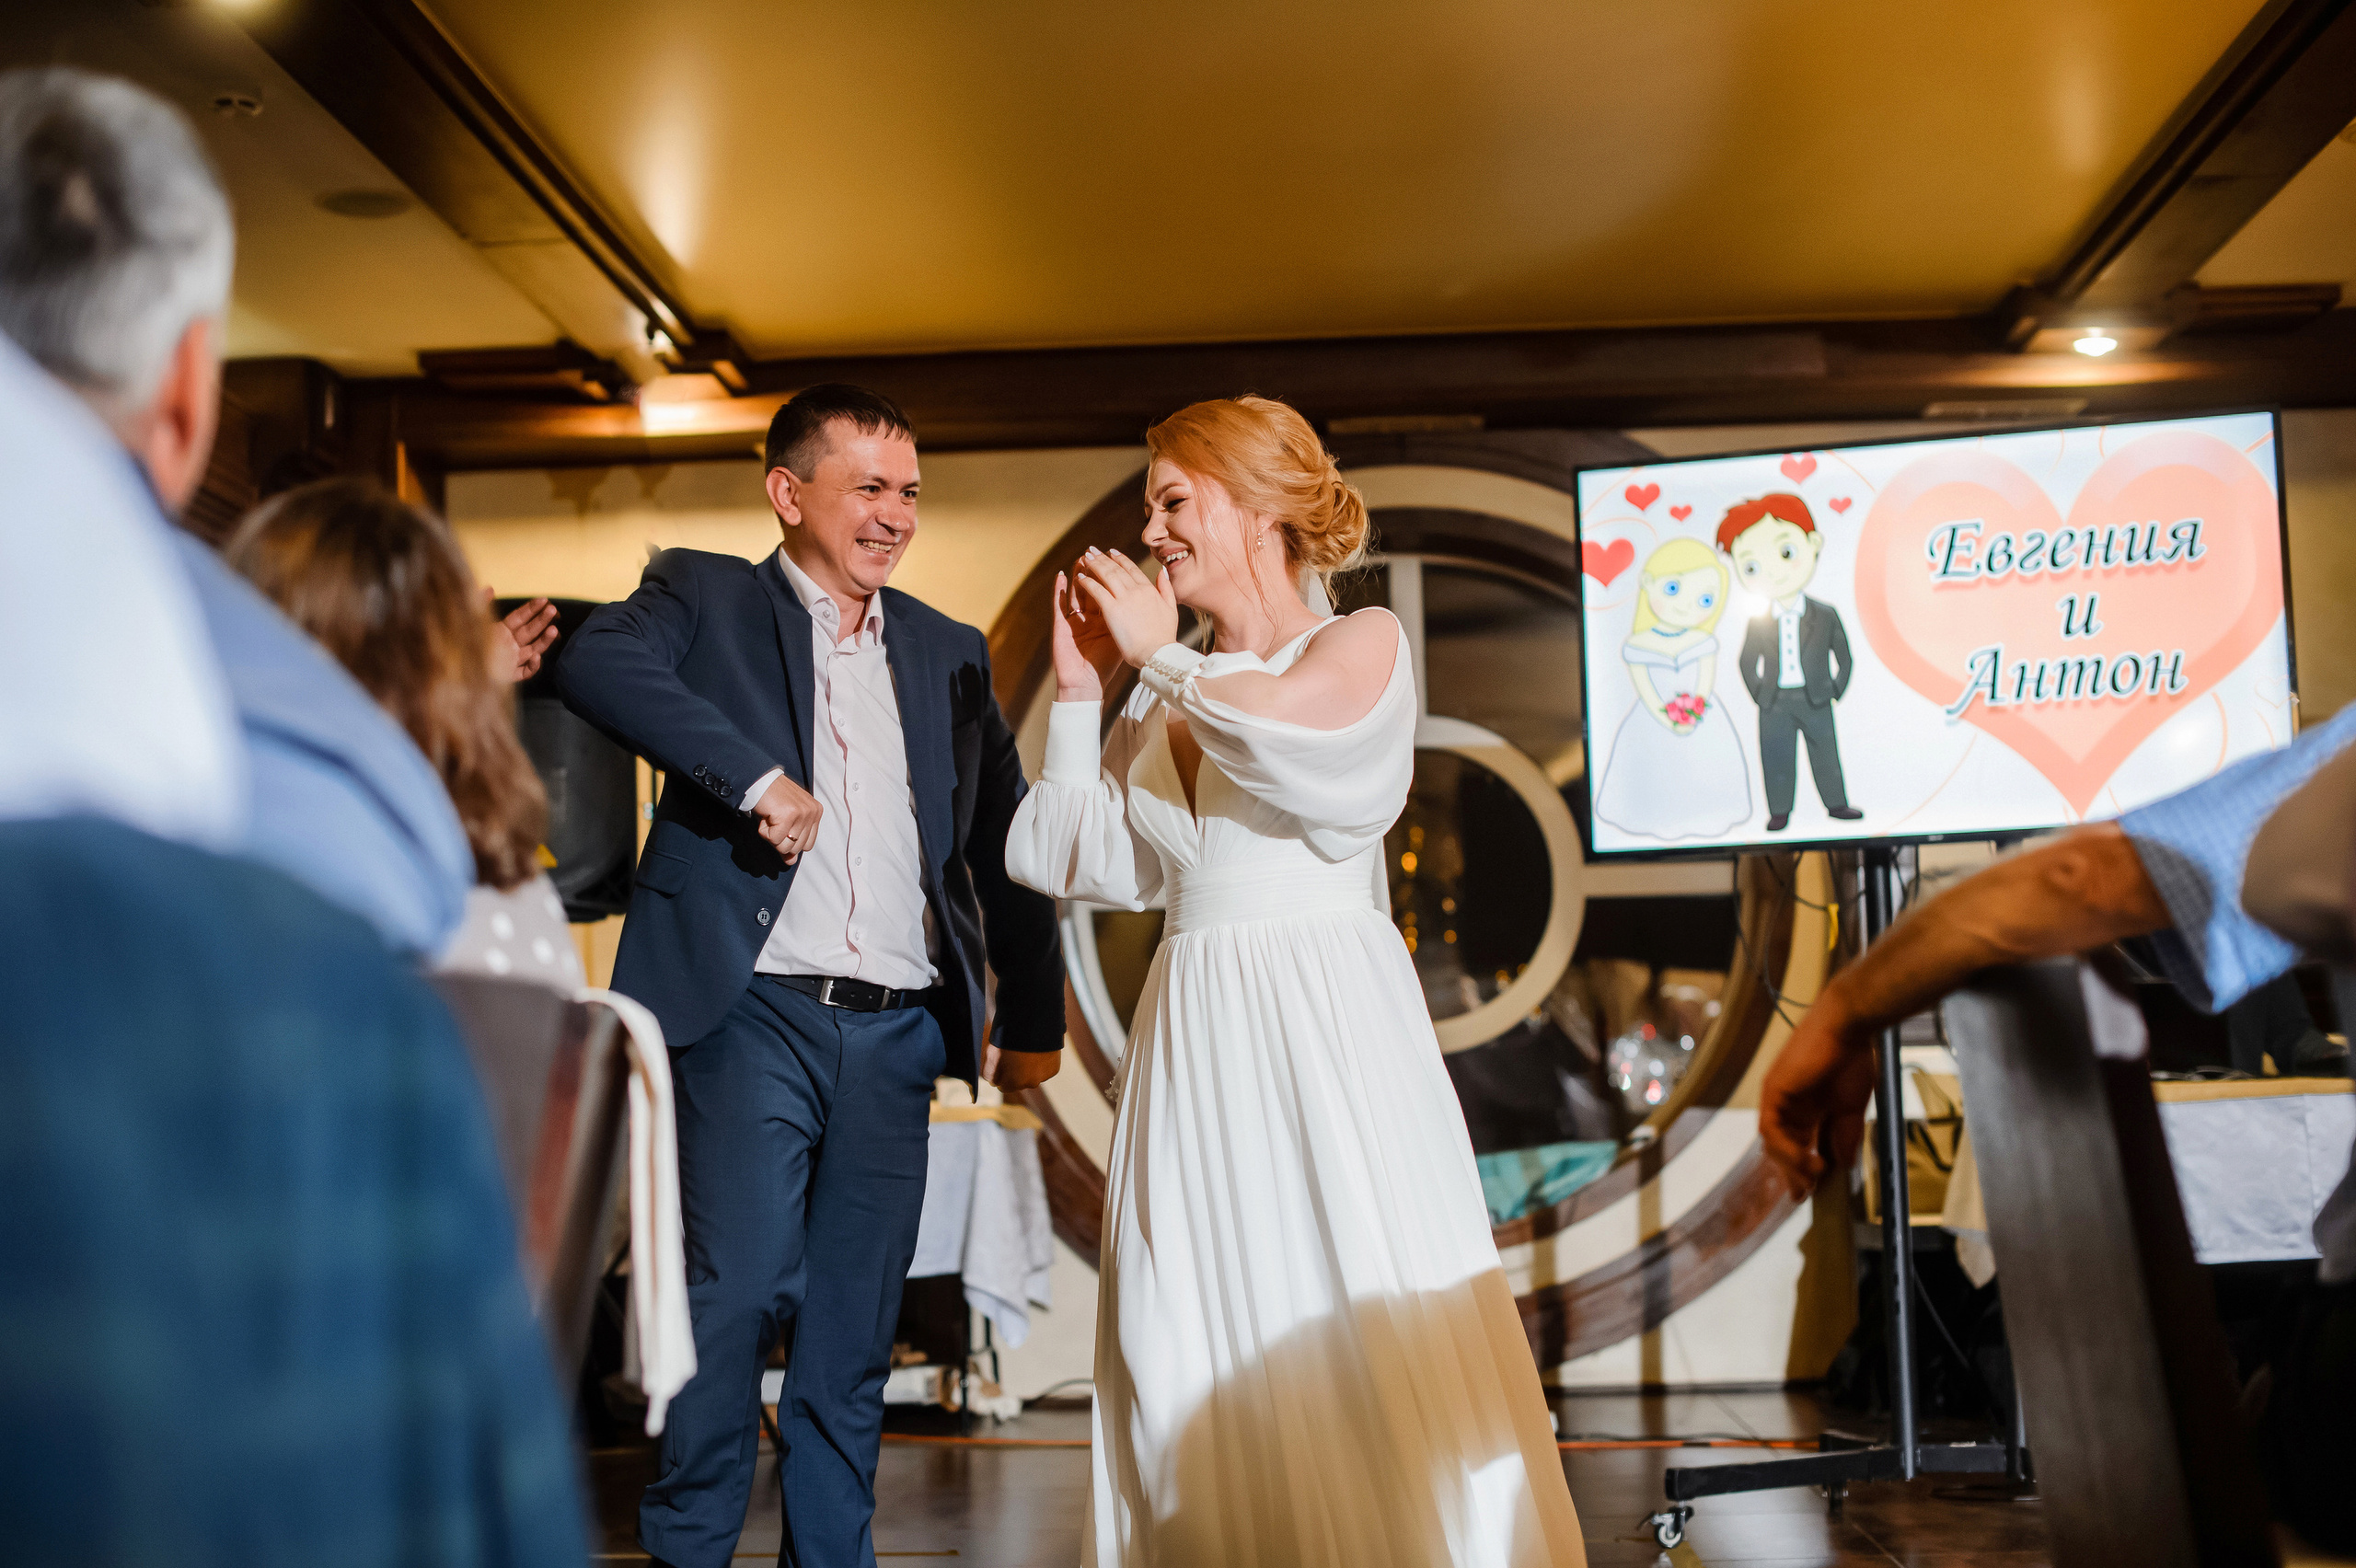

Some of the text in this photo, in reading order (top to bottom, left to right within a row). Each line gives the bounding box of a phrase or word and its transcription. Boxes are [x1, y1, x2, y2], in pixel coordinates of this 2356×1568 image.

[1927, 519, 2207, 580] Евгения
[2058, 593, 2104, 639] и
[1945, 645, 2188, 716] Антон
